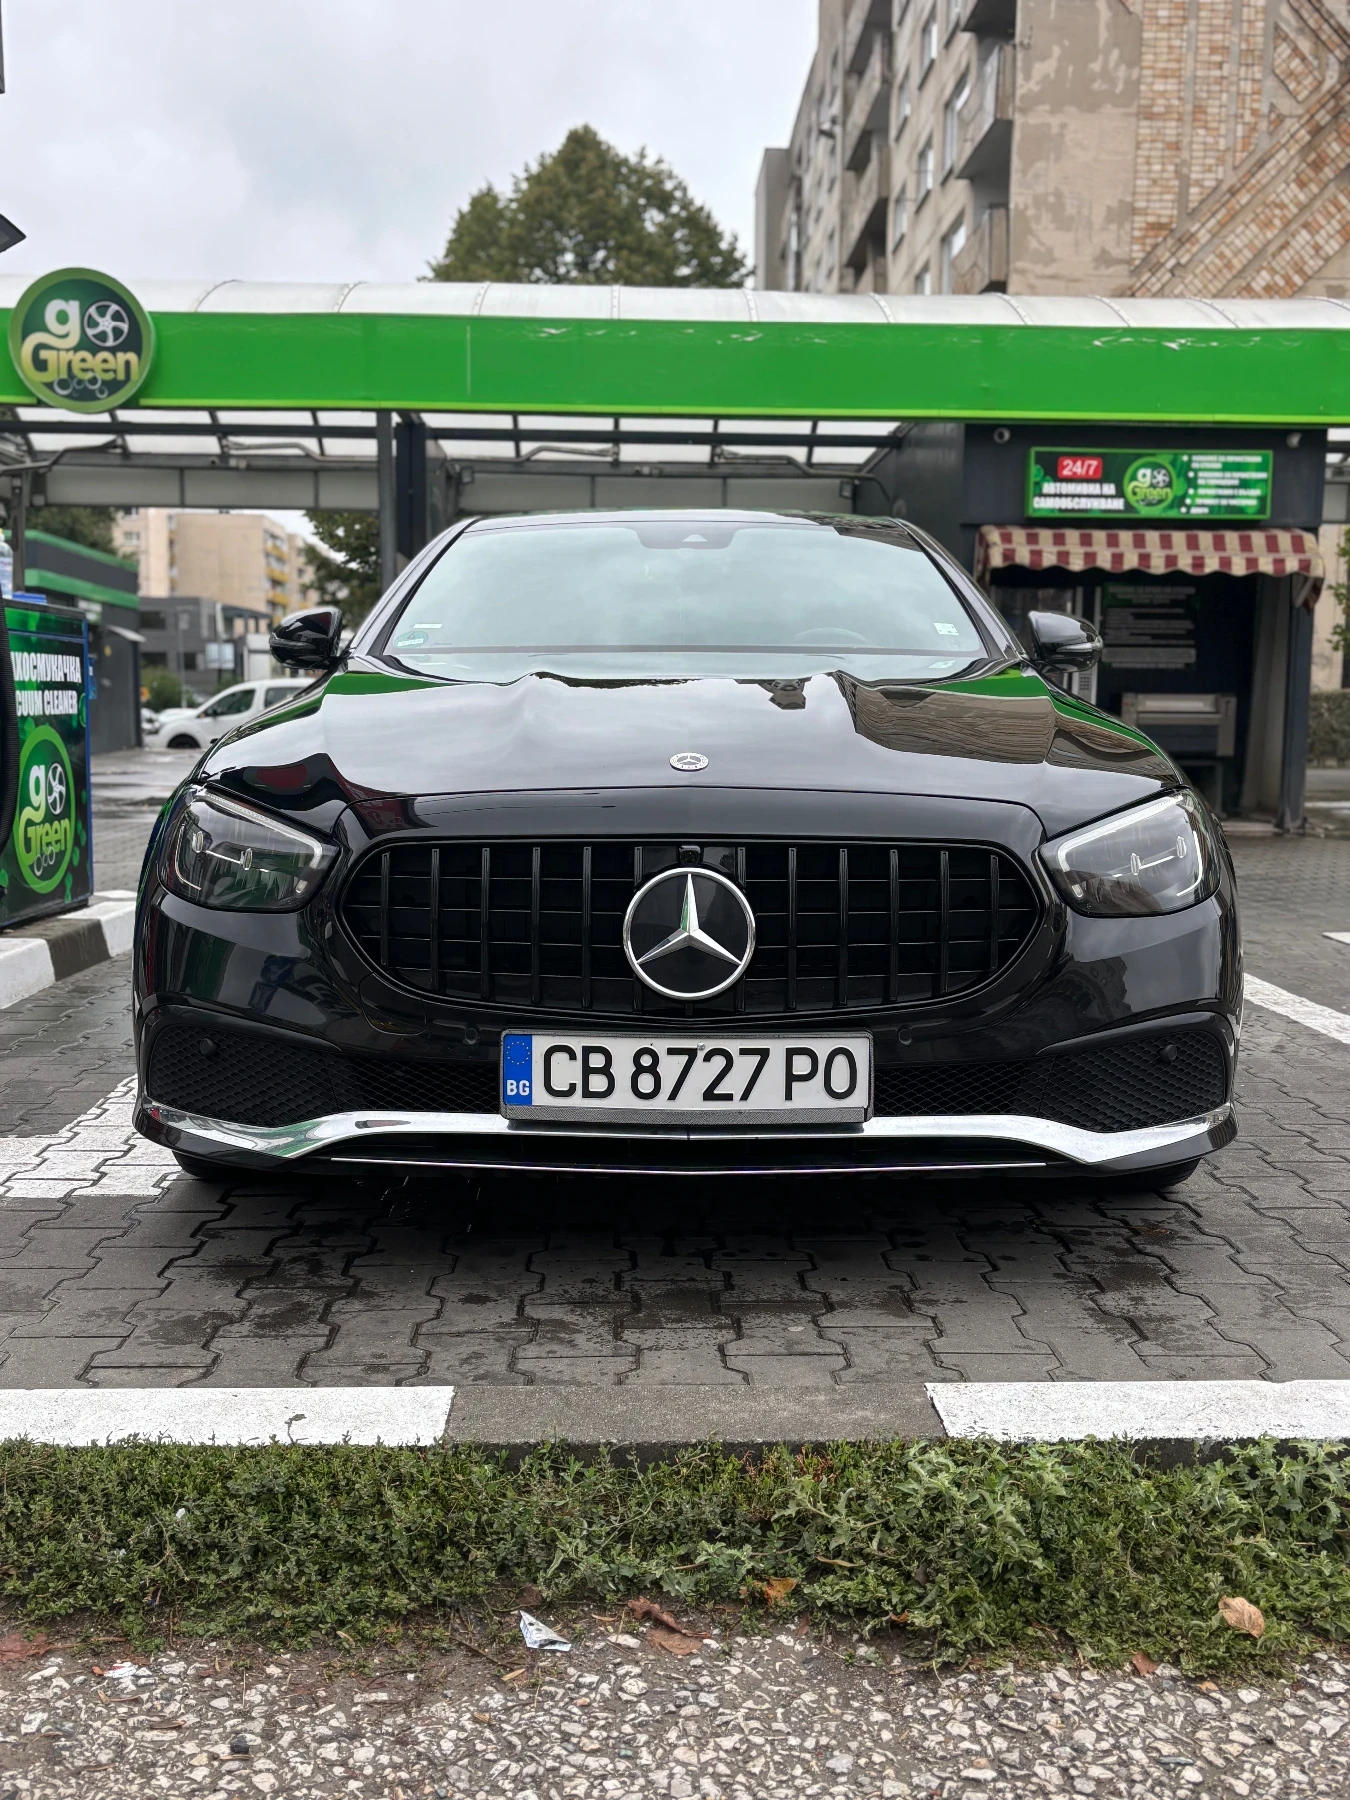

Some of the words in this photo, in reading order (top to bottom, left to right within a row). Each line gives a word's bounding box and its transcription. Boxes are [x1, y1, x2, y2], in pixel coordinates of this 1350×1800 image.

[21, 331, 140, 383] Green
[1062, 460, 1099, 476] 24/7
[1102, 483, 1116, 495] НА
[1128, 481, 1172, 500] Green
[15, 690, 43, 717] CUUM
[44, 689, 78, 716] CLEANER
[18, 807, 71, 866] Green
[543, 1044, 616, 1099] CB
[630, 1047, 771, 1102] 8727
[507, 1079, 530, 1097] BG
